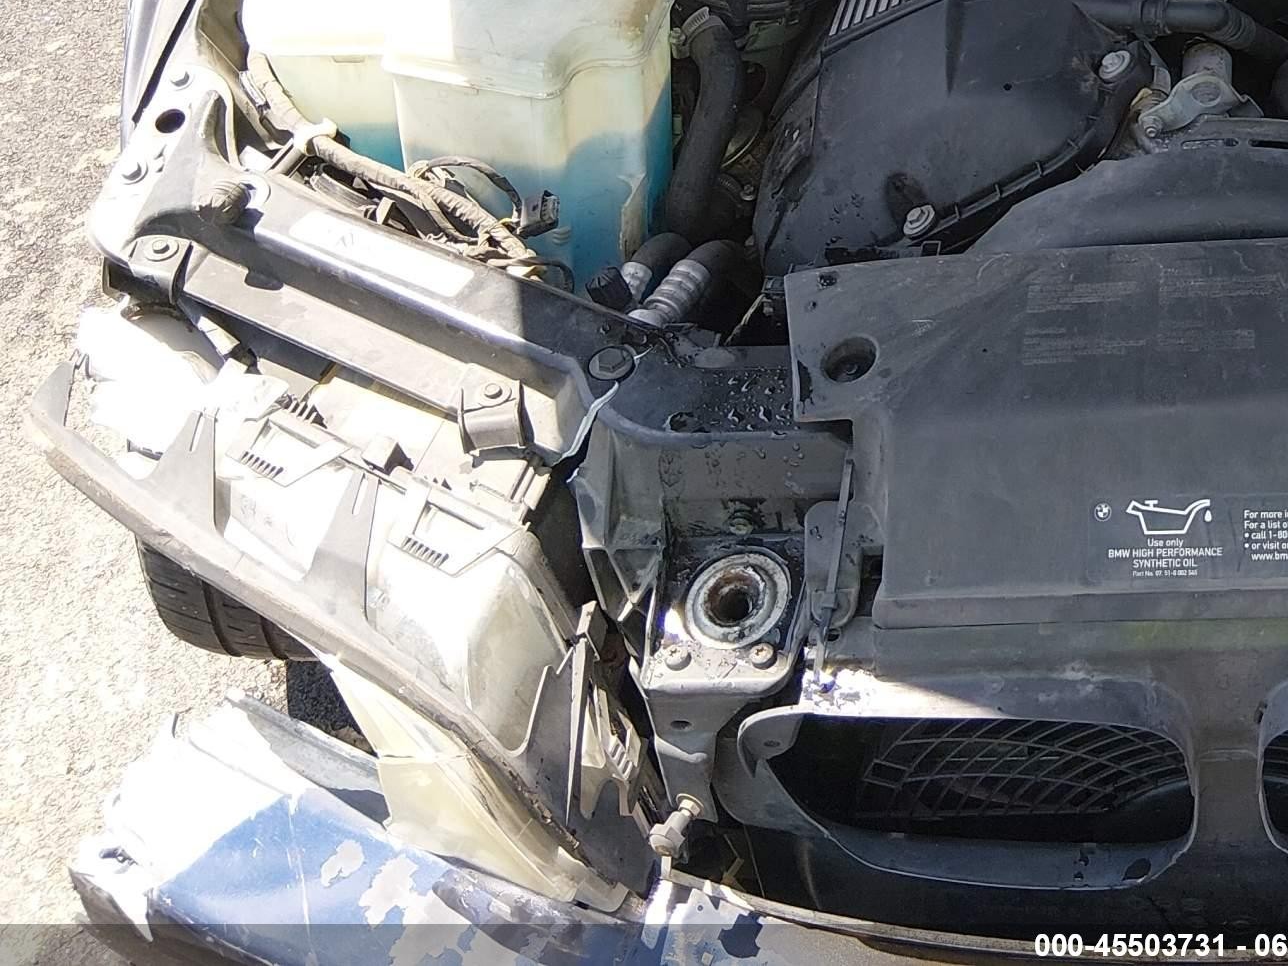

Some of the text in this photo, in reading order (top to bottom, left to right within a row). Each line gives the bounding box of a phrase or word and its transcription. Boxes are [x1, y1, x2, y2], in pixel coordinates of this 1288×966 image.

[1244, 510, 1258, 519] For
[1260, 511, 1282, 519] more
[1244, 520, 1258, 529] For
[1267, 520, 1280, 529] list
[1251, 531, 1266, 539] call
[1147, 538, 1184, 548] Use only
[1251, 542, 1261, 550] or
[1262, 540, 1280, 550] visit
[1108, 547, 1223, 559] BMW HIGH PERFORMANCE
[1132, 558, 1198, 569] SYNTHETIC OIL
